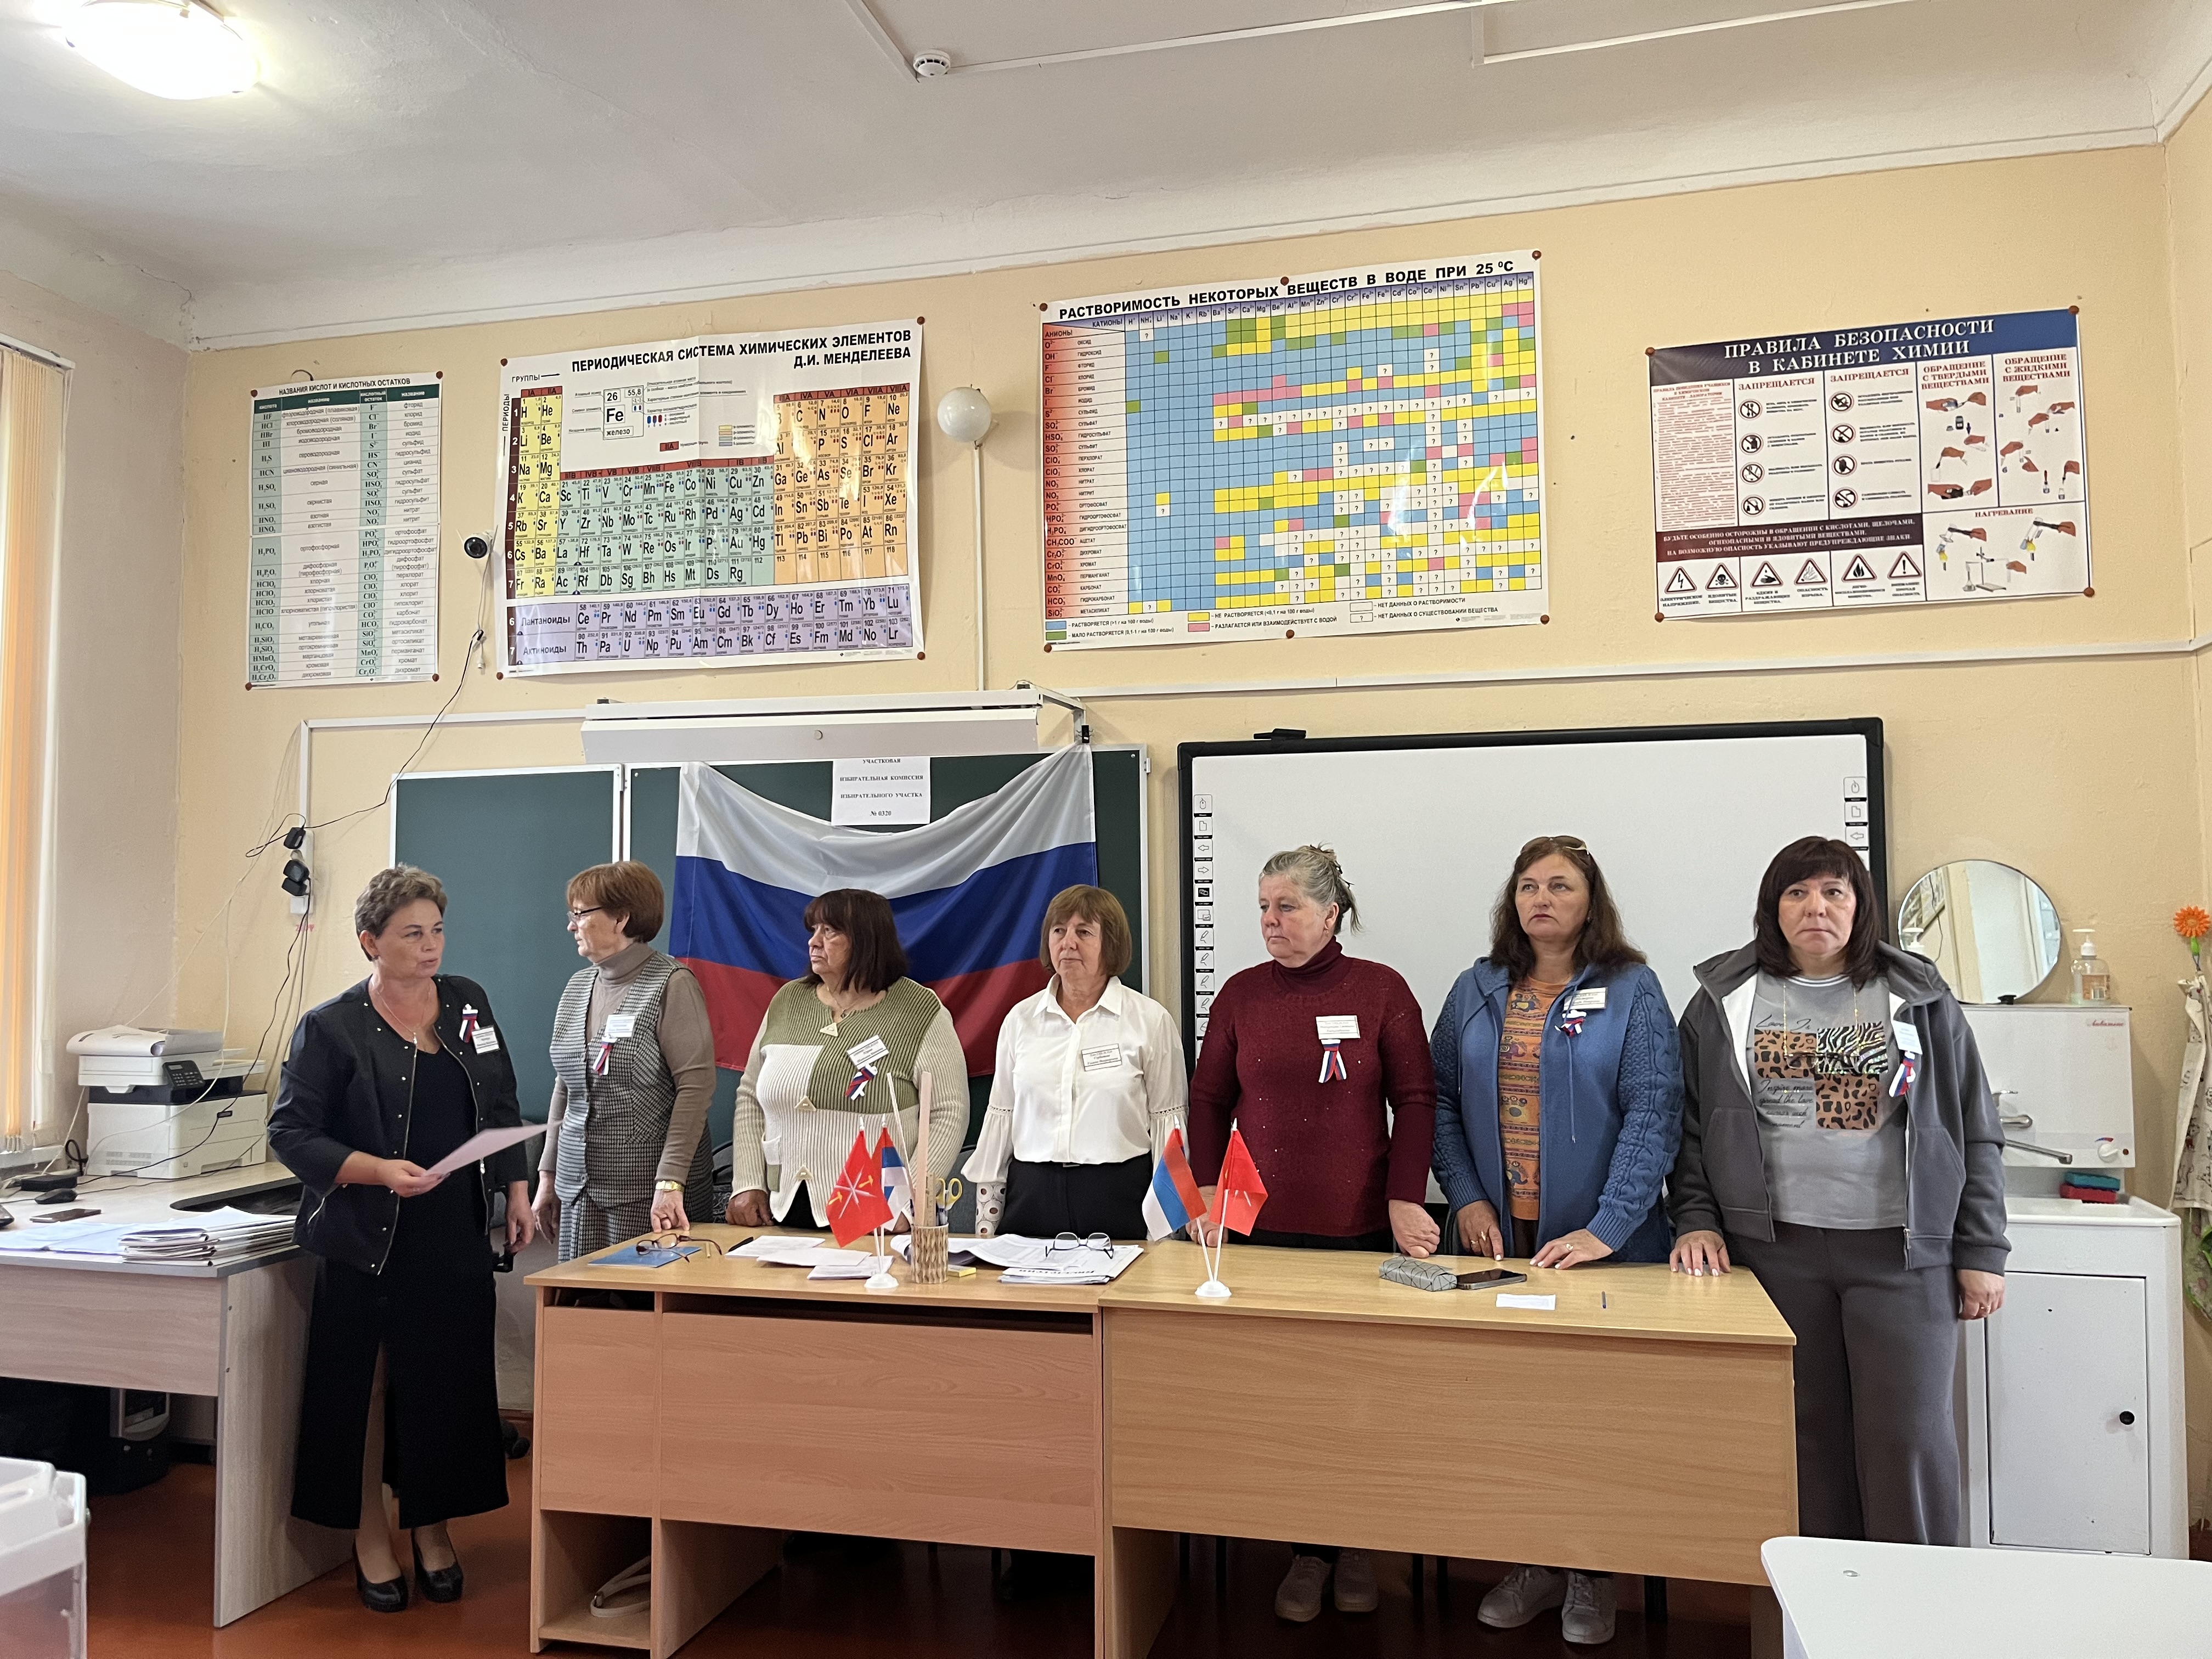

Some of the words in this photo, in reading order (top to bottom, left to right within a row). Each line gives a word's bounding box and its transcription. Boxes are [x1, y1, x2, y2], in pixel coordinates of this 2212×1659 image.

[1059, 295, 1181, 319] РАСТВОРИМОСТЬ
[1189, 286, 1279, 304] НЕКОТОРЫХ
[1287, 276, 1357, 296] ВЕЩЕСТВ
[1367, 274, 1375, 285] В
[1386, 269, 1426, 284] ВОДЕ
[1436, 266, 1466, 279] ПРИ
[1476, 263, 1493, 275] 25
[1092, 318, 1123, 328] КАТИОНЫ
[1725, 336, 1821, 359] ПРАВИЛА
[1834, 319, 1994, 347] БЕЗОПАСНОСТИ
[572, 351, 673, 372] ПЕРИОДИЧЕСКАЯ
[678, 345, 735, 360] СИСТЕМА
[740, 338, 827, 355] ХИМИЧЕСКИХ
[832, 330, 911, 348] ЭЛЕМЕНТОВ
[1748, 361, 1760, 374] В
[1773, 348, 1880, 372] КАБИНЕТЕ
[1892, 340, 1970, 360] ХИМИИ
[794, 355, 820, 369] Д.И.
[824, 347, 911, 364] МЕНДЕЛЕЕВА
[2005, 354, 2067, 364] ОБРАЩЕНИЕ
[1923, 361, 1985, 373] ОБРАЩЕНИЕ
[2014, 362, 2067, 372] ЖИДКИМИ
[512, 374, 540, 382] ГРУППЫ
[1830, 369, 1909, 382] ЗАПРЕЩАЕТСЯ
[1931, 369, 1986, 380] ТВЕРДЫМИ
[2003, 371, 2070, 382] ВЕЩЕСТВАМИ
[279, 386, 308, 395] НАЗВАНИЯ
[339, 380, 376, 389] КИСЛОТНЫХ
[378, 378, 410, 386] ОСТАТКОВ
[1739, 378, 1815, 391] ЗАПРЕЩАЕТСЯ
[1921, 377, 1989, 390] ВЕЩЕСТВАМИ
[607, 392, 618, 401] 26
[522, 407, 527, 418] H
[542, 404, 553, 416] He
[607, 408, 624, 422] Fe
[820, 408, 825, 421] N
[842, 407, 849, 419] O
[865, 405, 870, 416] F
[888, 403, 900, 415] Ne
[797, 410, 803, 422] C
[521, 435, 527, 446] Li
[541, 433, 551, 445] Be
[819, 438, 825, 450] P
[842, 437, 847, 449] S
[864, 435, 873, 447] Cl
[887, 433, 898, 445] Ar
[520, 464, 530, 475] Na
[540, 462, 552, 476] Mg
[862, 465, 873, 477] Br
[885, 463, 896, 475] Kr
[665, 481, 674, 493] Fe
[706, 477, 715, 489] Ni
[730, 477, 742, 489] Cu
[753, 476, 764, 487] Zn
[644, 483, 655, 495] Mn
[540, 492, 550, 503] Ca
[885, 493, 896, 505] Xe
[706, 507, 718, 519] Pd
[796, 501, 807, 514] Sn
[1975, 508, 2033, 517] НАГРЕВАНИЕ
[730, 507, 743, 521] Ag
[516, 520, 527, 532] Rb
[581, 517, 590, 529] Zr
[623, 515, 635, 526] Mo
[885, 524, 897, 536] Rn
[1775, 525, 1818, 534] ОБРАЩЕНИИ
[753, 537, 765, 550] Hg
[797, 533, 808, 544] Pb
[1810, 536, 1884, 546] ПРЕДУПРЕЖДАЮЩИЕ
[535, 548, 546, 559] Ba
[580, 545, 589, 557] Hf
[670, 610, 685, 620] Sm
[718, 606, 730, 618] Gd
[1419, 608, 1466, 617] СУЩЕСТВОВАНИИ
[522, 616, 570, 626] Лантаноиды
[578, 613, 589, 624] Ce
[1263, 618, 1313, 626] ВЗАИМОДЕЙСТВУЕТ
[889, 628, 898, 640] Lr
[577, 641, 587, 653] Th
[670, 638, 681, 650] Pu
[523, 646, 566, 655] Актиноиды
